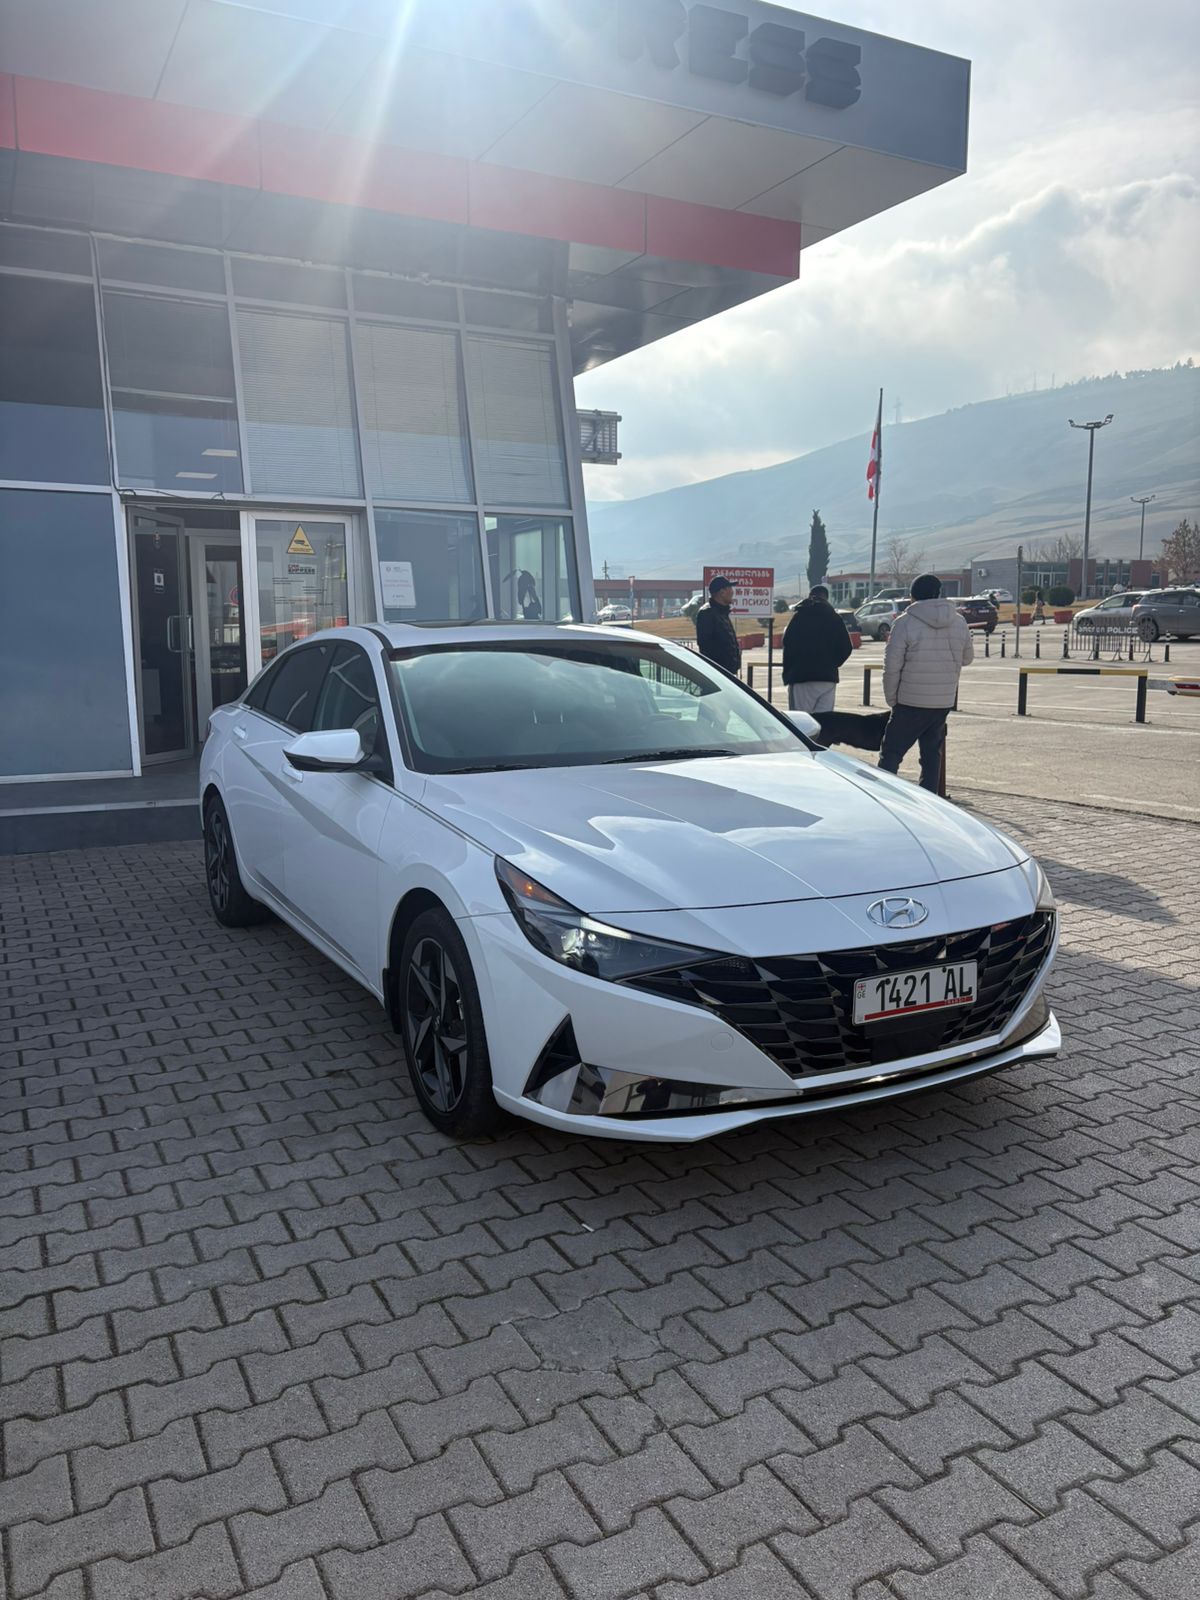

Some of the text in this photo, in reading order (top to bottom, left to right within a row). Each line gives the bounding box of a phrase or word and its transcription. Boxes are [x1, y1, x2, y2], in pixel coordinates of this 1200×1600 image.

[1107, 626, 1139, 634] POLICE
[875, 966, 973, 1011] 1421 AL
